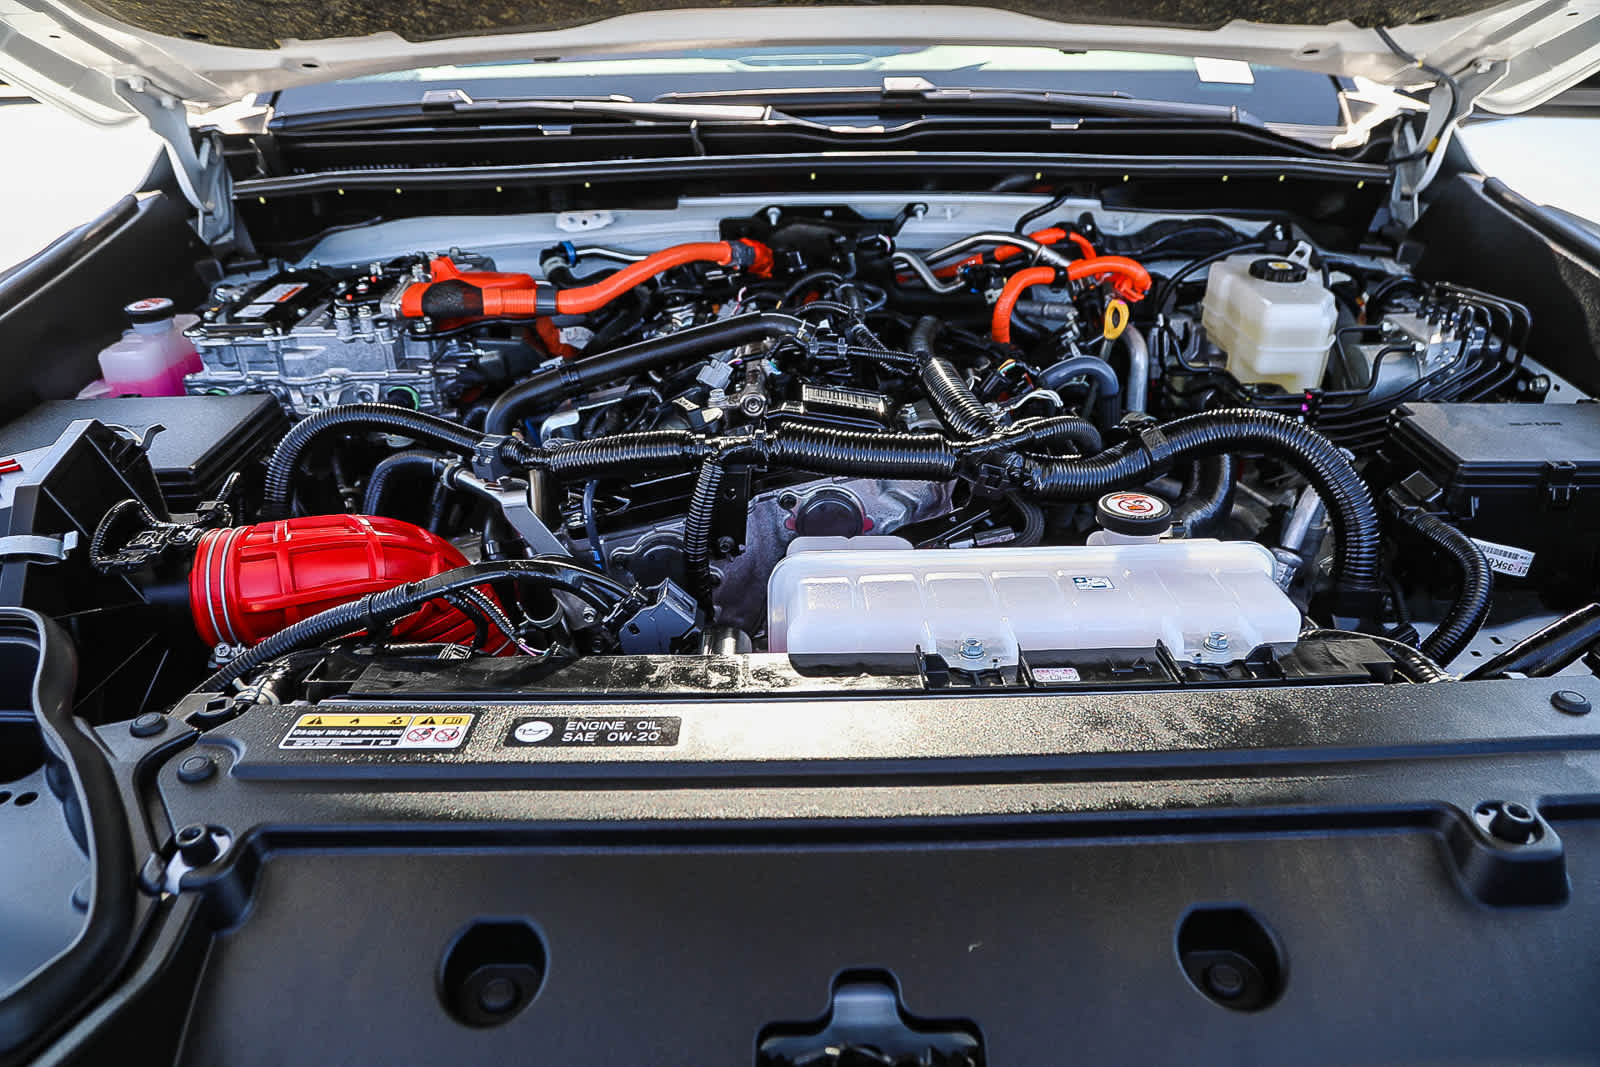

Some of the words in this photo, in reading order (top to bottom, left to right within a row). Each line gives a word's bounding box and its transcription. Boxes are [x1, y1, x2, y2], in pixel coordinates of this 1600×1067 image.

[565, 720, 626, 731] ENGINE
[636, 720, 662, 731] OIL
[562, 731, 596, 742] SAE
[607, 731, 661, 742] 0W-20
